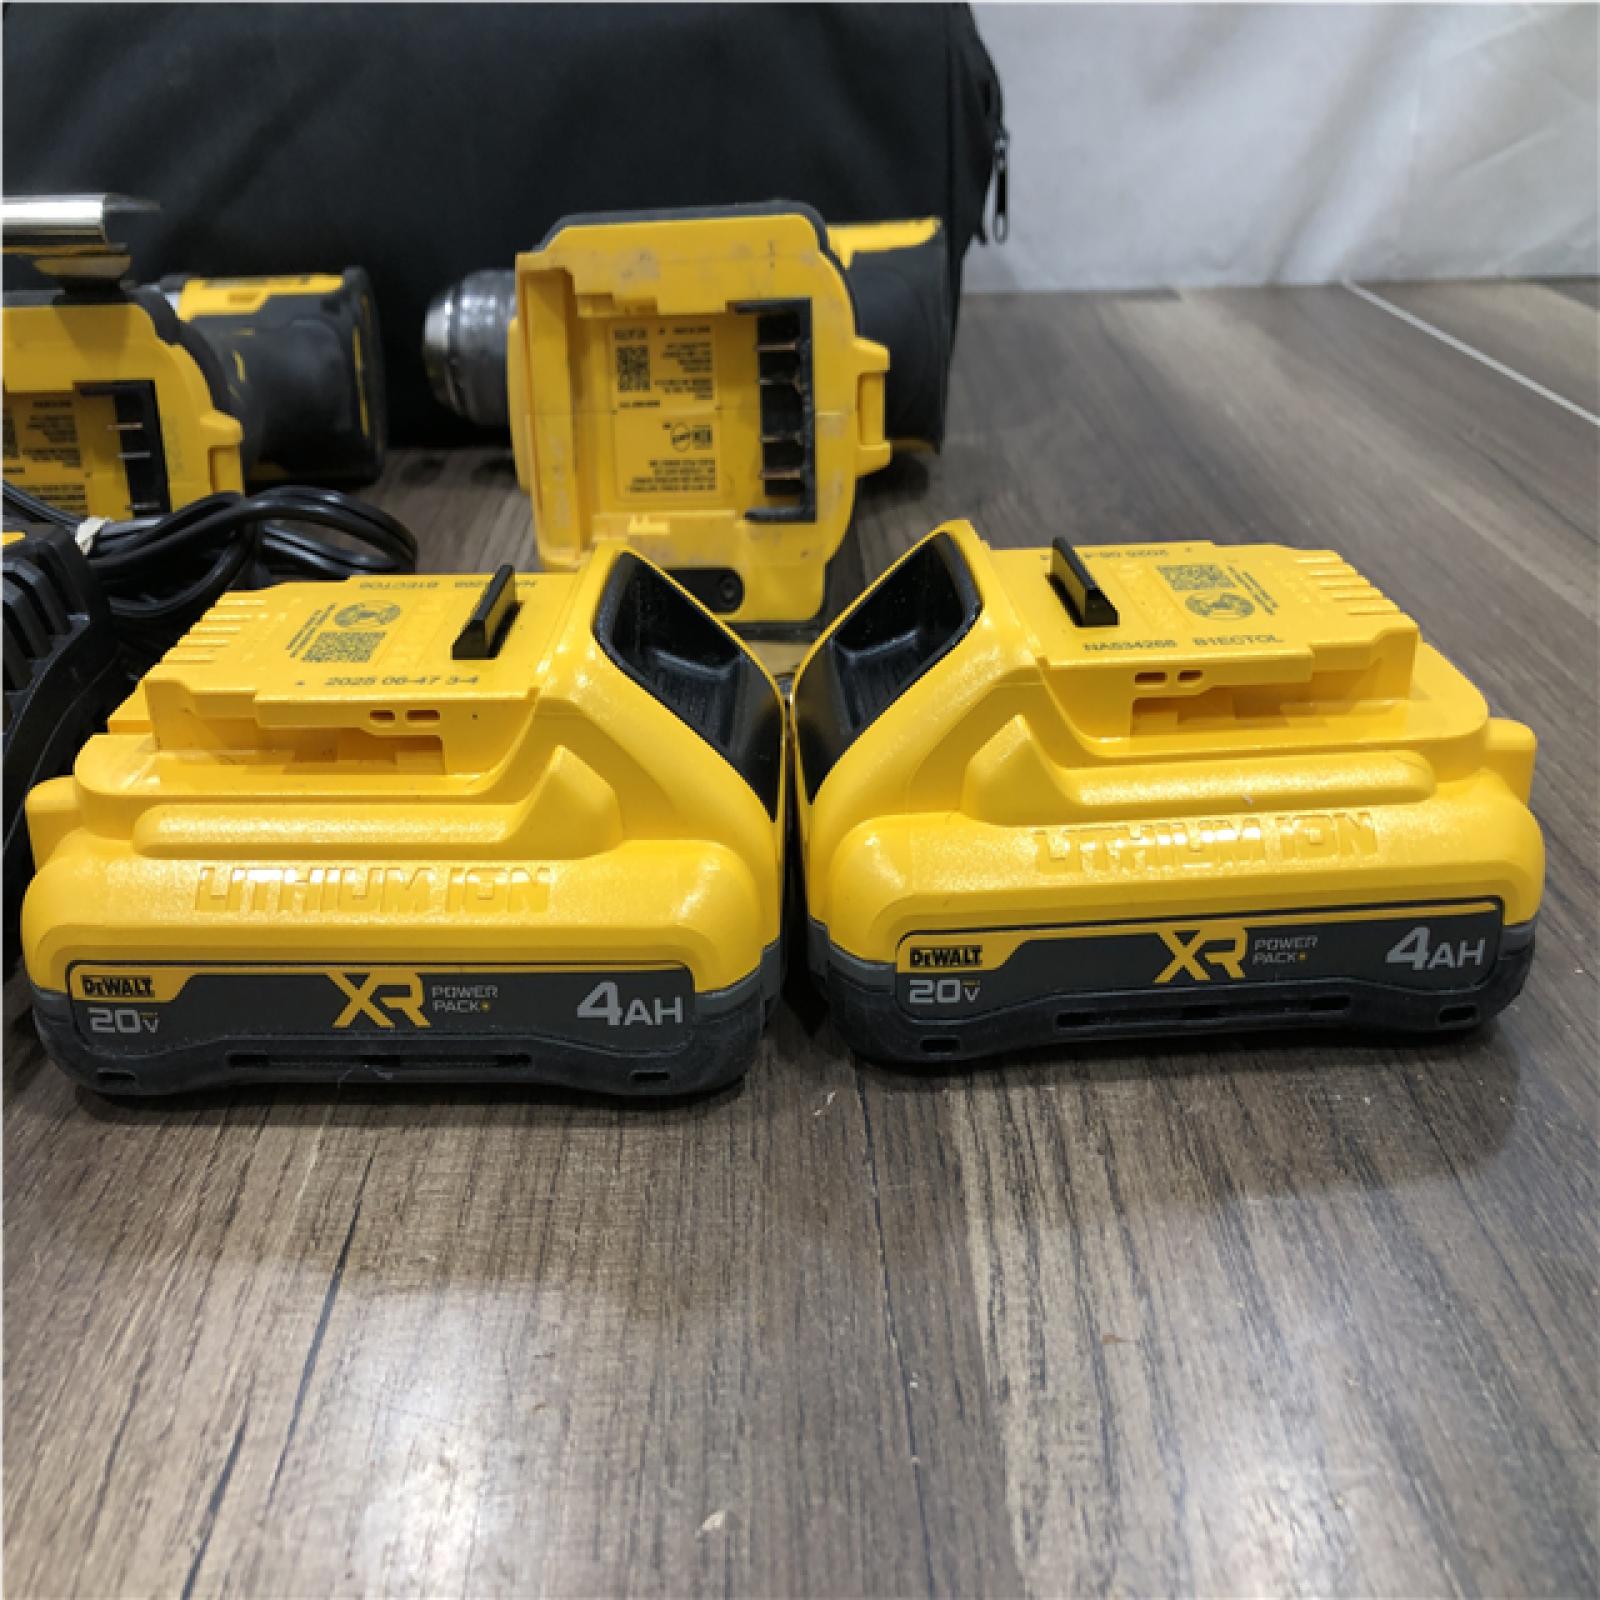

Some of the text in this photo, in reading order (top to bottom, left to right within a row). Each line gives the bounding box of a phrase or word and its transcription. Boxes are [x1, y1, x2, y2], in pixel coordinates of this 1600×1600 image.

[1034, 812, 1378, 874] LITHIUM ION
[194, 867, 553, 913] LITHIUM ION
[1153, 927, 1247, 984] XR
[1253, 936, 1318, 950] POWER
[1386, 927, 1485, 970] 4AH
[332, 973, 431, 1028] XR
[432, 985, 499, 998] POWER
[576, 980, 684, 1026] 4AH
[909, 979, 980, 1003] 20V
[87, 1008, 158, 1033] 20V
